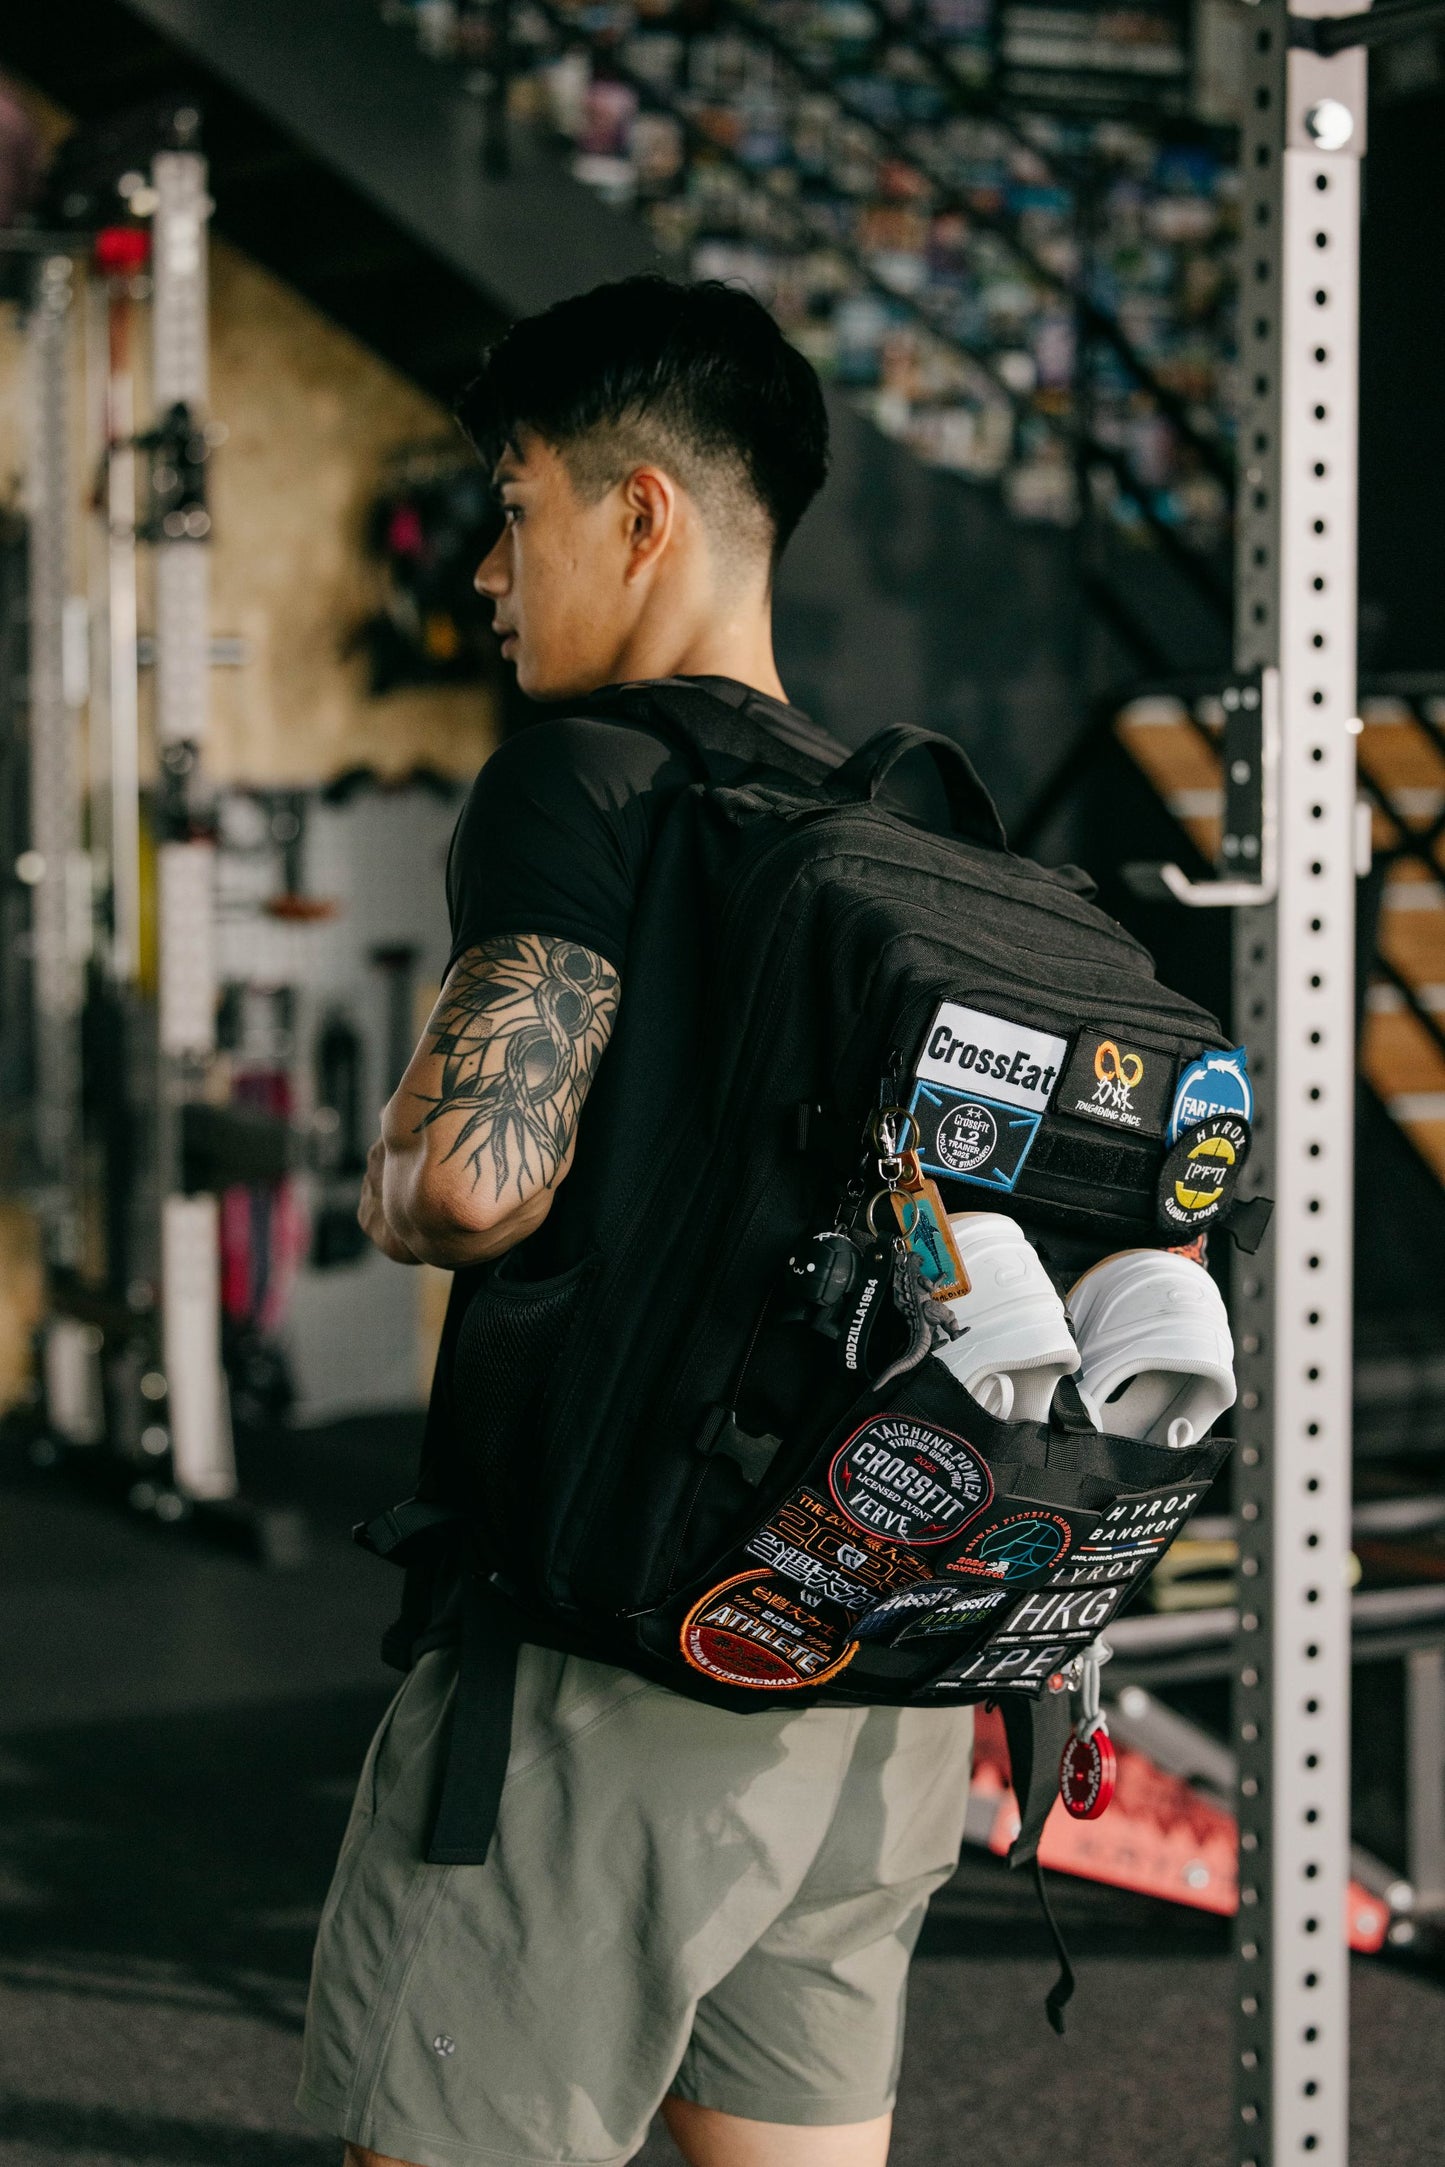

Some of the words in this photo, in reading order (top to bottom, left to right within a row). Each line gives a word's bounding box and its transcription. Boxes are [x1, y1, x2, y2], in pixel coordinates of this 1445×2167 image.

[928, 1026, 1055, 1095] CrossEat
[1075, 1100, 1119, 1120] TOUGHENING
[1119, 1112, 1142, 1127] SPACE
[1180, 1096, 1207, 1120] FAR
[1207, 1102, 1244, 1118] EA
[939, 1133, 948, 1154] HOLD
[945, 1153, 958, 1166] THE
[959, 1145, 991, 1168] STANDARD
[948, 1139, 980, 1155] TRAINER
[955, 1128, 980, 1145] L2
[1196, 1121, 1246, 1149] HYROX
[845, 1279, 879, 1370] GODZILLA1954
[851, 1442, 965, 1521] CROSSFIT
[869, 1422, 954, 1454] TAICHUNG
[950, 1451, 982, 1502] POWER
[887, 1437, 930, 1453] FITNESS
[928, 1448, 956, 1472] GRAND
[949, 1470, 963, 1490] PRIX
[913, 1454, 939, 1474] 2025
[799, 1494, 828, 1517] THE
[825, 1513, 862, 1539] ZONE
[849, 1489, 912, 1535] VERVE
[855, 1472, 902, 1502] LICENSED
[901, 1499, 933, 1522] EVENT
[1105, 1493, 1198, 1521] HYROX
[965, 1524, 999, 1553] TAIWAN
[1002, 1511, 1051, 1525] FITNESS
[1088, 1517, 1180, 1541] BANGKOK
[946, 1563, 1006, 1580] COMPETITOR
[760, 1610, 806, 1637] 2025
[1006, 1587, 1118, 1632] HKG
[689, 1629, 711, 1666] TAIWAN
[707, 1664, 799, 1686] STRONGMAN
[704, 1604, 827, 1675] ATHLETE
